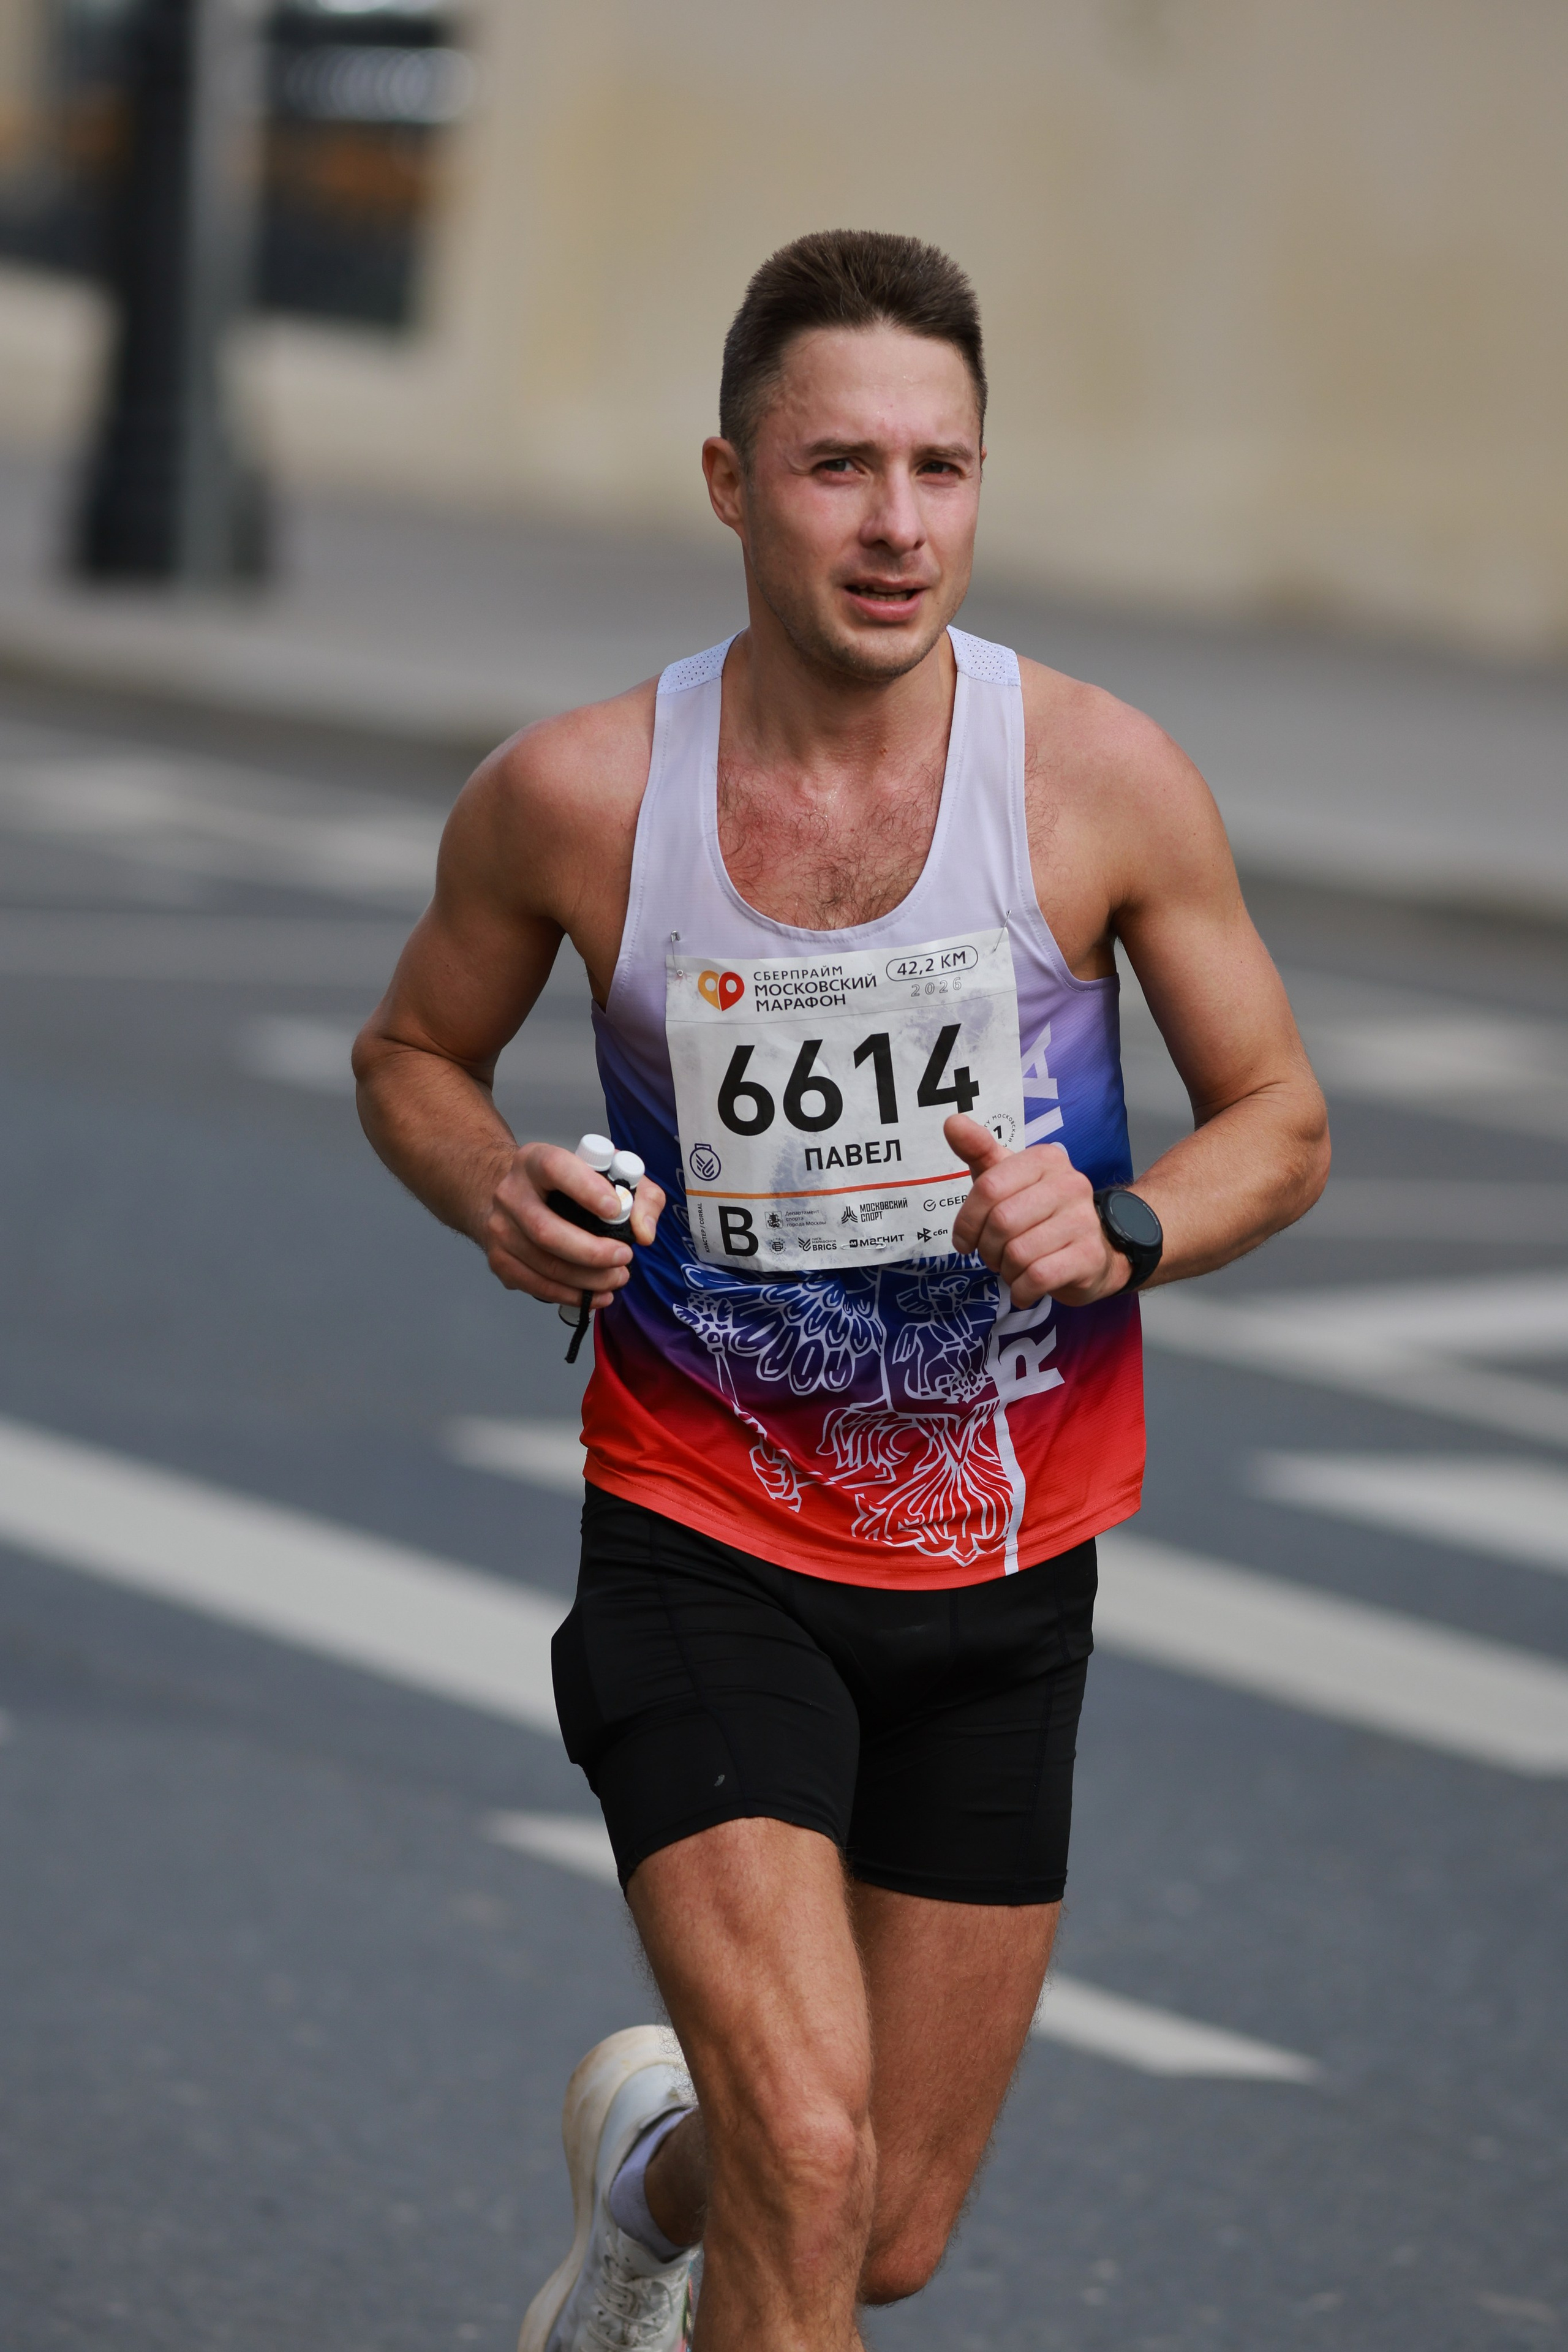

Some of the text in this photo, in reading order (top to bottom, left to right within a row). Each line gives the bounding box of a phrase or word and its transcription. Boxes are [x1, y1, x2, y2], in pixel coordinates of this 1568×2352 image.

[753, 965, 843, 981] СБЕРПРАЙМ
[897, 951, 967, 976] 42,2 КМ
[754, 973, 878, 997] МОСКОВСКИЙ
[910, 976, 962, 997] 2026
[755, 993, 846, 1012] МАРАФОН
[717, 1023, 980, 1136] 6614
[993, 1125, 1003, 1139] 1
[804, 1139, 902, 1171] ПАВЕЛ
[859, 1197, 908, 1213] МОСКОВСКИЙ
[861, 1211, 883, 1223] СПОРТ
[701, 1229, 710, 1253] КЛАСТЕР
[718, 1205, 759, 1257] B
